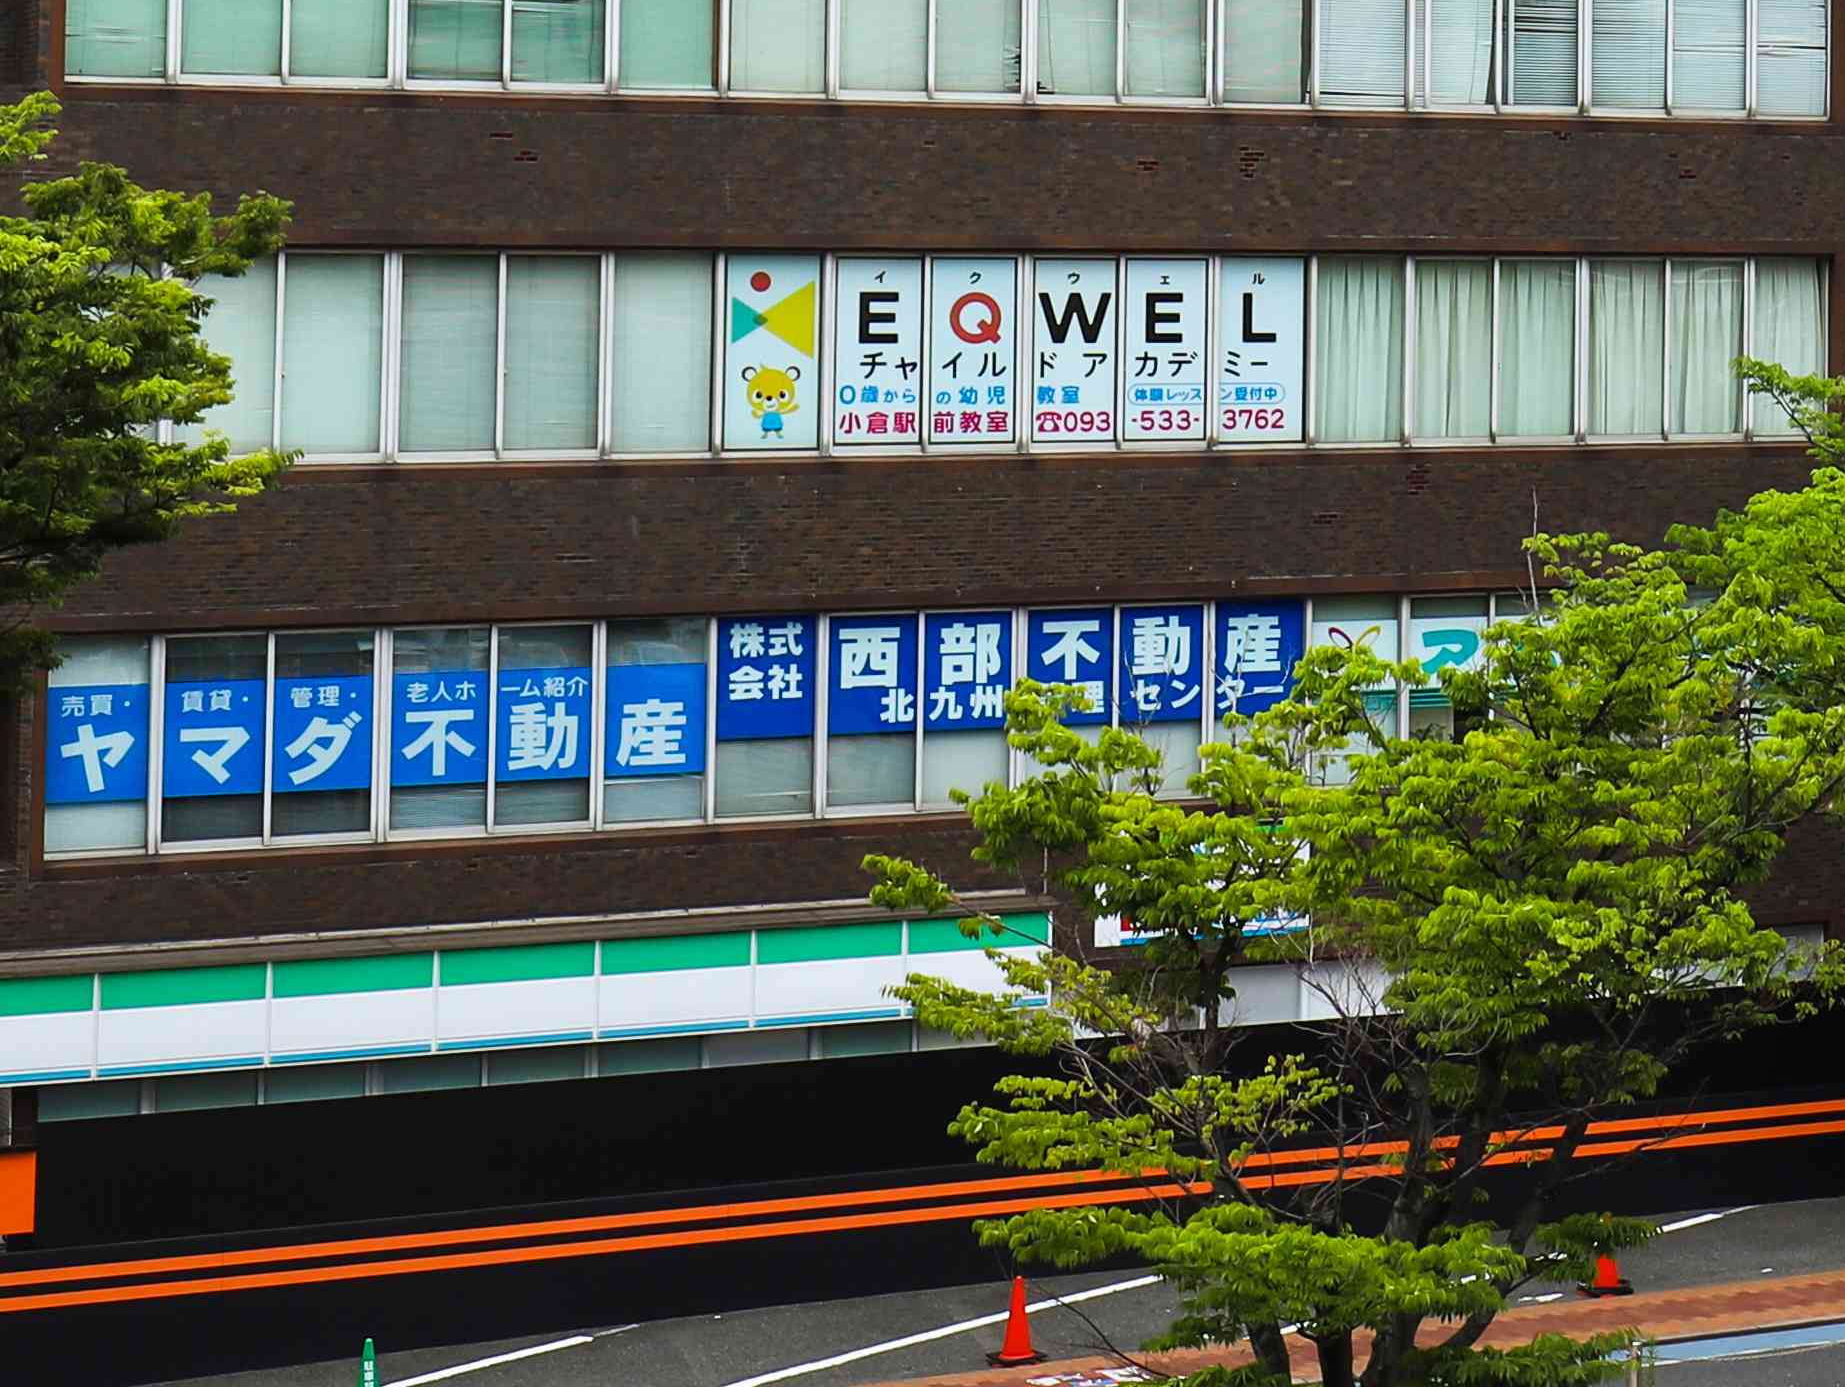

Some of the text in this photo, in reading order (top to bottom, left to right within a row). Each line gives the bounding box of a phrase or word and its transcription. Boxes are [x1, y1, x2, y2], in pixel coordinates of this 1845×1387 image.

[857, 291, 1277, 344] EQWEL
[860, 351, 1268, 381] チャイルドアカデミー
[839, 410, 1009, 434] 小倉駅前教室
[838, 613, 1282, 689] 西部不動産
[879, 674, 1284, 724] 北九州理センター
[60, 698, 687, 794] ヤマダ不動産
